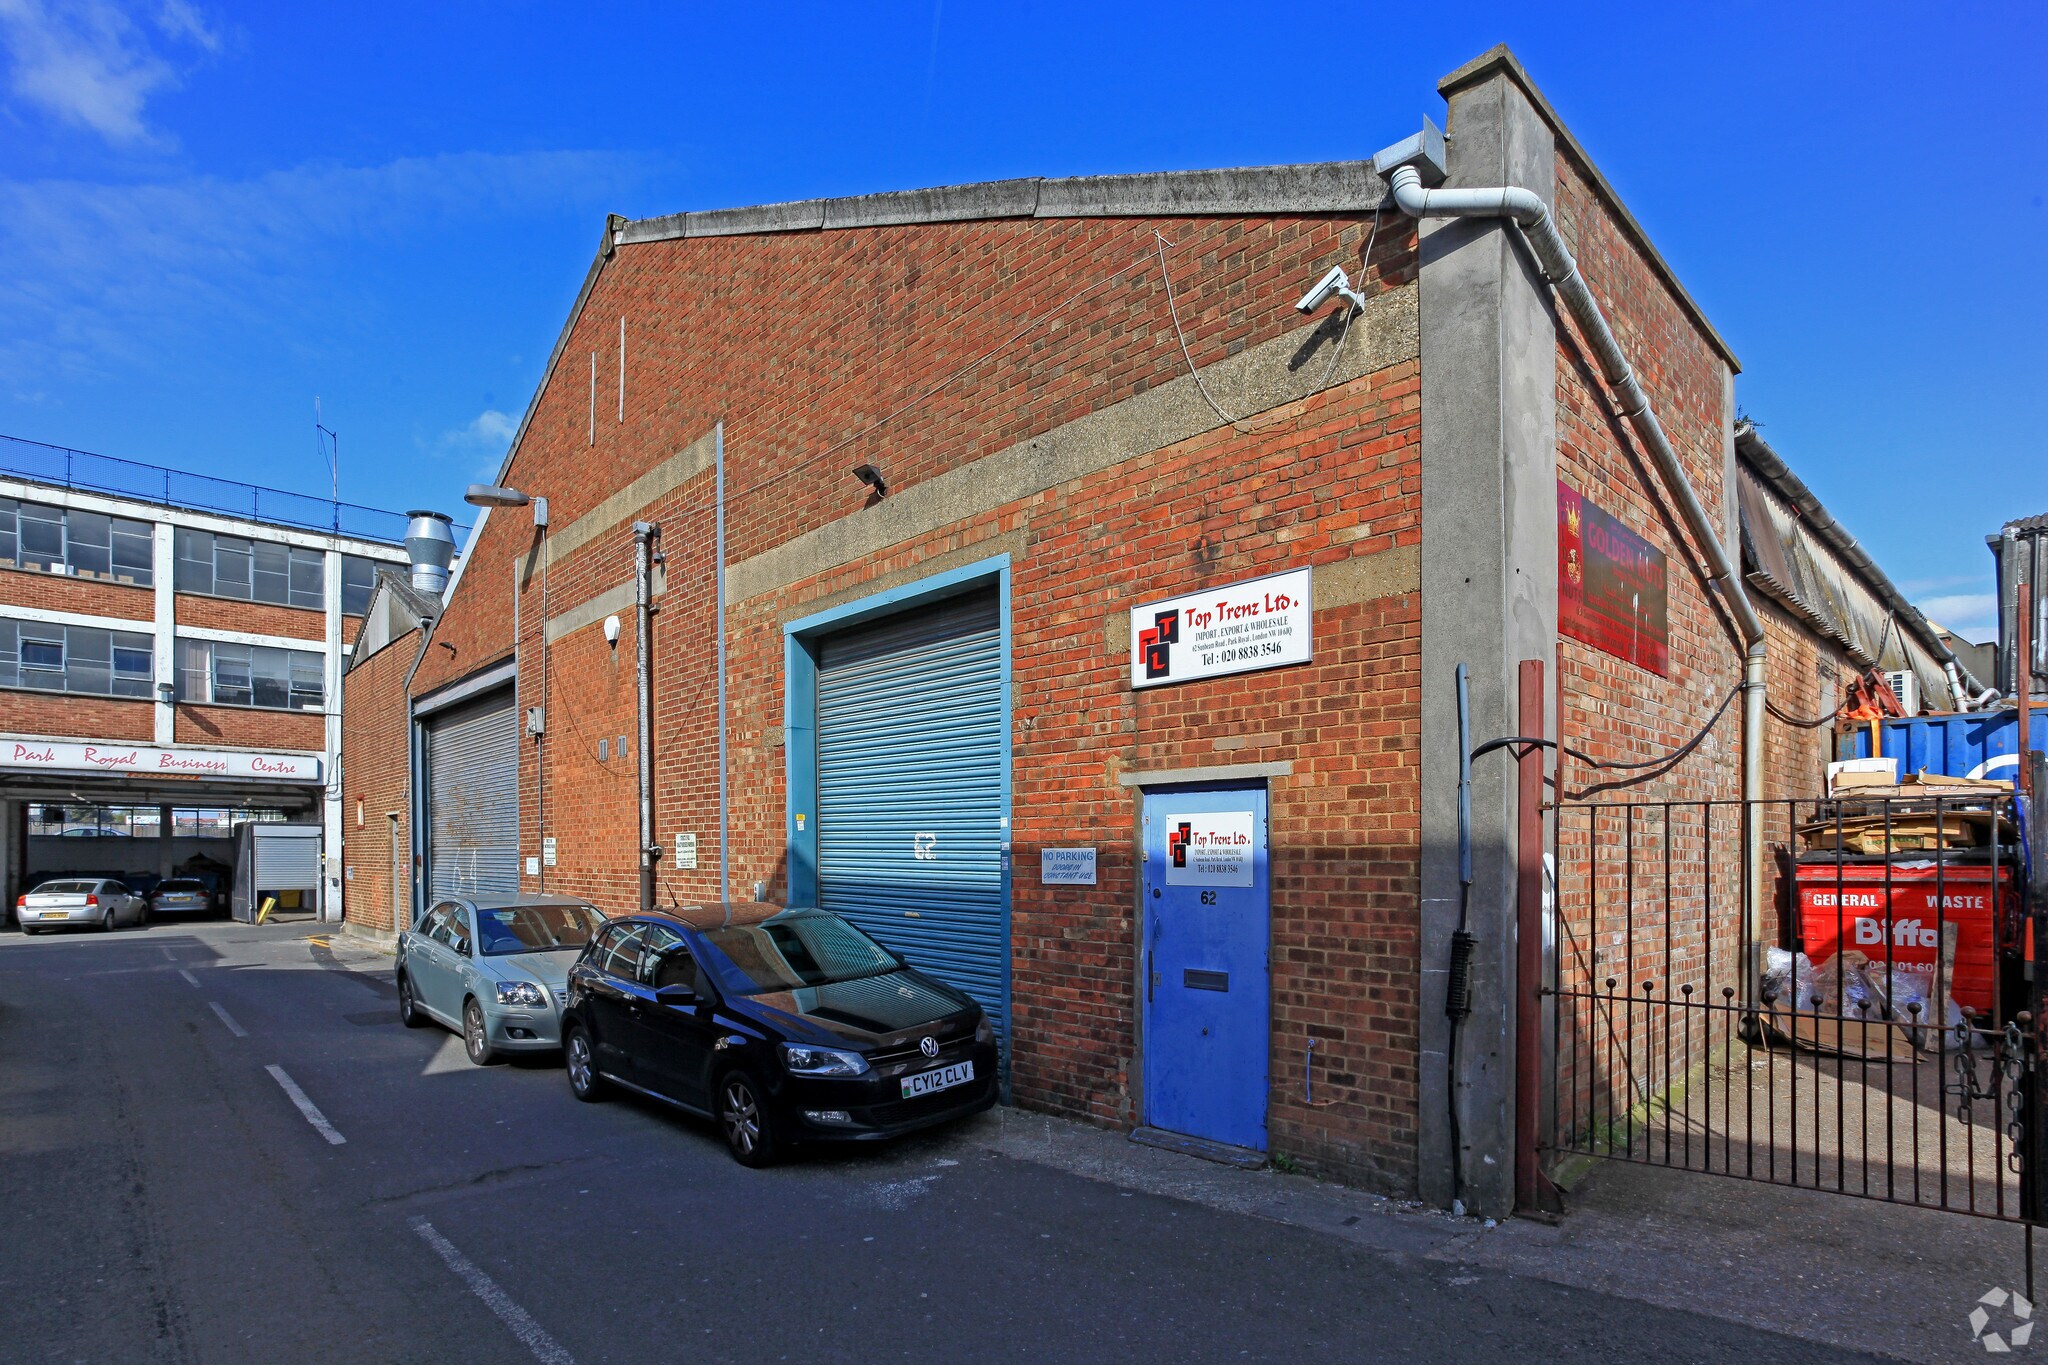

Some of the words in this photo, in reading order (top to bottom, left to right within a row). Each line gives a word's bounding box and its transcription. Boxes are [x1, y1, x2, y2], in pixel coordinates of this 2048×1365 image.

[1587, 521, 1634, 572] GOLDEN
[1637, 552, 1664, 590] NUTS
[1185, 608, 1212, 629] Top
[1216, 601, 1259, 622] Trenz
[1221, 624, 1243, 636] EXPORT
[1244, 623, 1250, 632] &
[1250, 616, 1288, 630] WHOLESALE
[1221, 649, 1236, 662] 020
[1239, 645, 1259, 660] 8838
[1260, 641, 1282, 657] 3546
[13, 744, 55, 761] Park
[84, 747, 137, 769] Royal
[159, 753, 227, 770] Business
[251, 757, 296, 773] Centre
[1193, 832, 1207, 848] Top
[1209, 832, 1231, 845] Trenz
[1043, 852, 1053, 861] NO
[1056, 851, 1094, 861] PARKING
[1200, 890, 1217, 906] 62
[1813, 893, 1879, 907] GENERAL
[1926, 895, 1984, 909] WASTE
[913, 1071, 943, 1092] CY12
[945, 1064, 968, 1084] CLV
